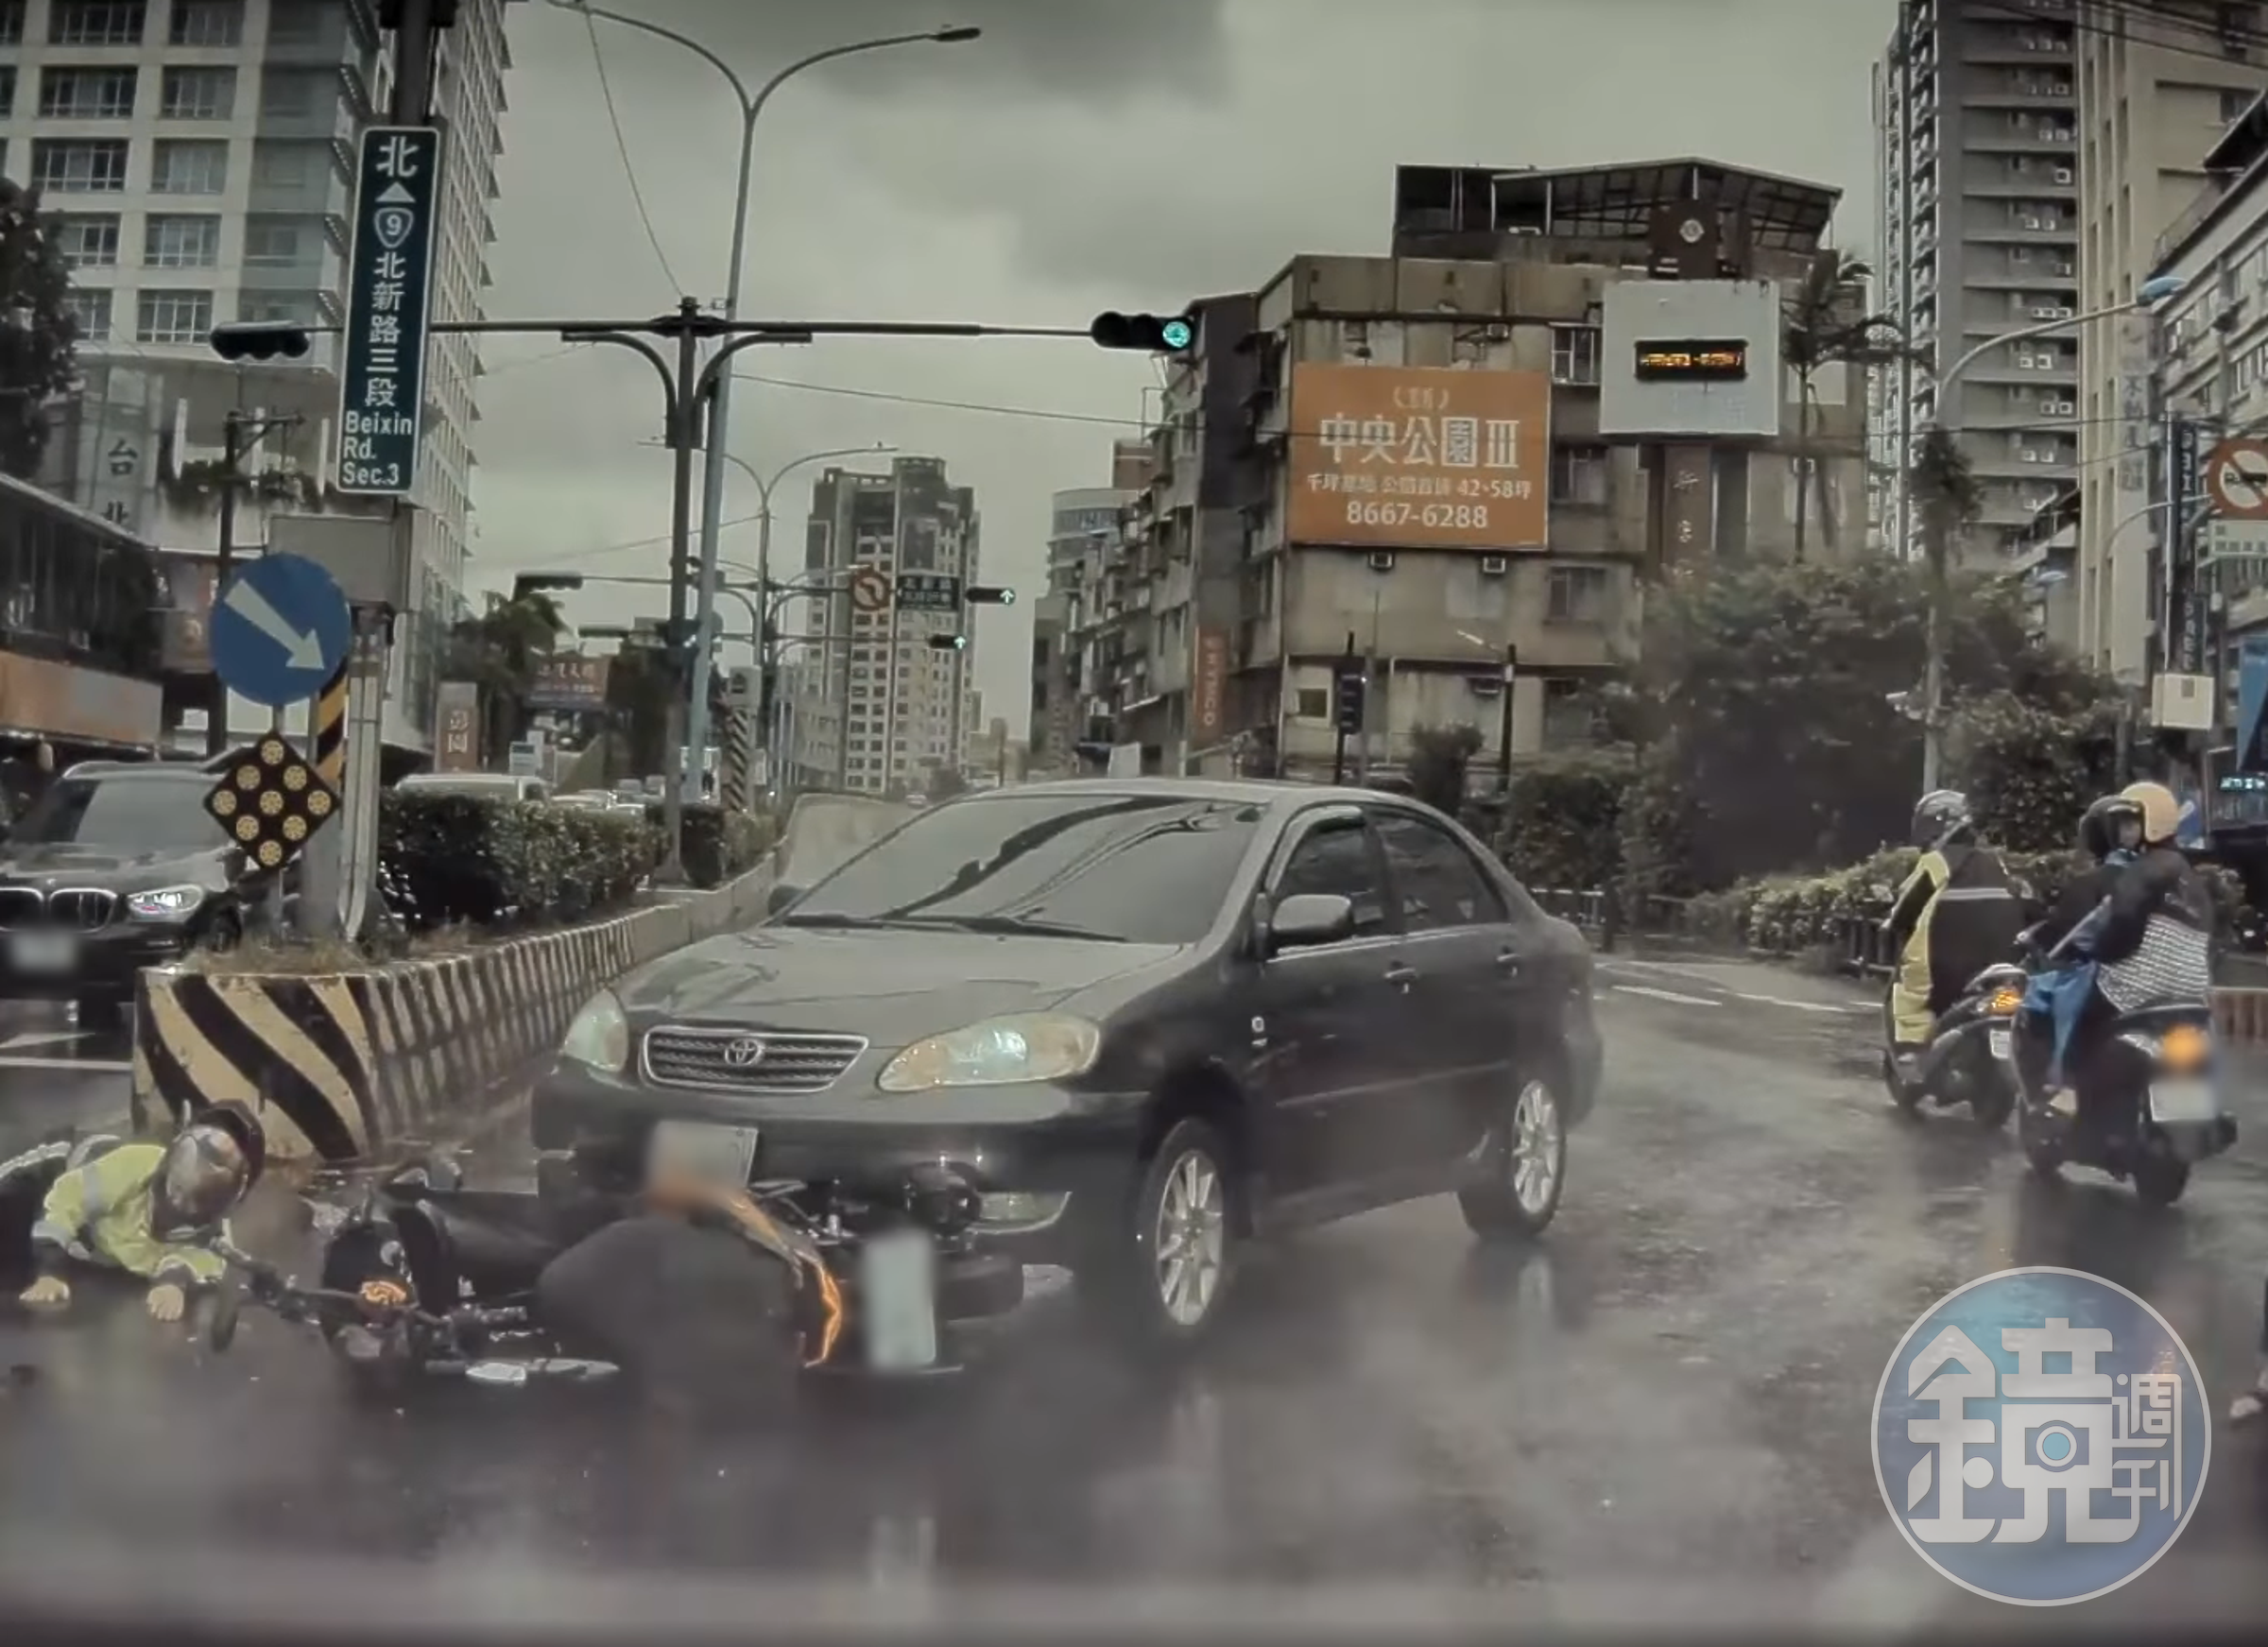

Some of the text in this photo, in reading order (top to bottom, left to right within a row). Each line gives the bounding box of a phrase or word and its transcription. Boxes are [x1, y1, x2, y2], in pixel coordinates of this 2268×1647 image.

[376, 135, 421, 178] 北
[387, 214, 403, 236] 9
[364, 250, 407, 407] 北新路三段
[345, 411, 412, 436] Beixin
[343, 436, 377, 460] Rd.
[342, 461, 400, 486] Sec.3
[1347, 501, 1488, 528] 8667-6288
